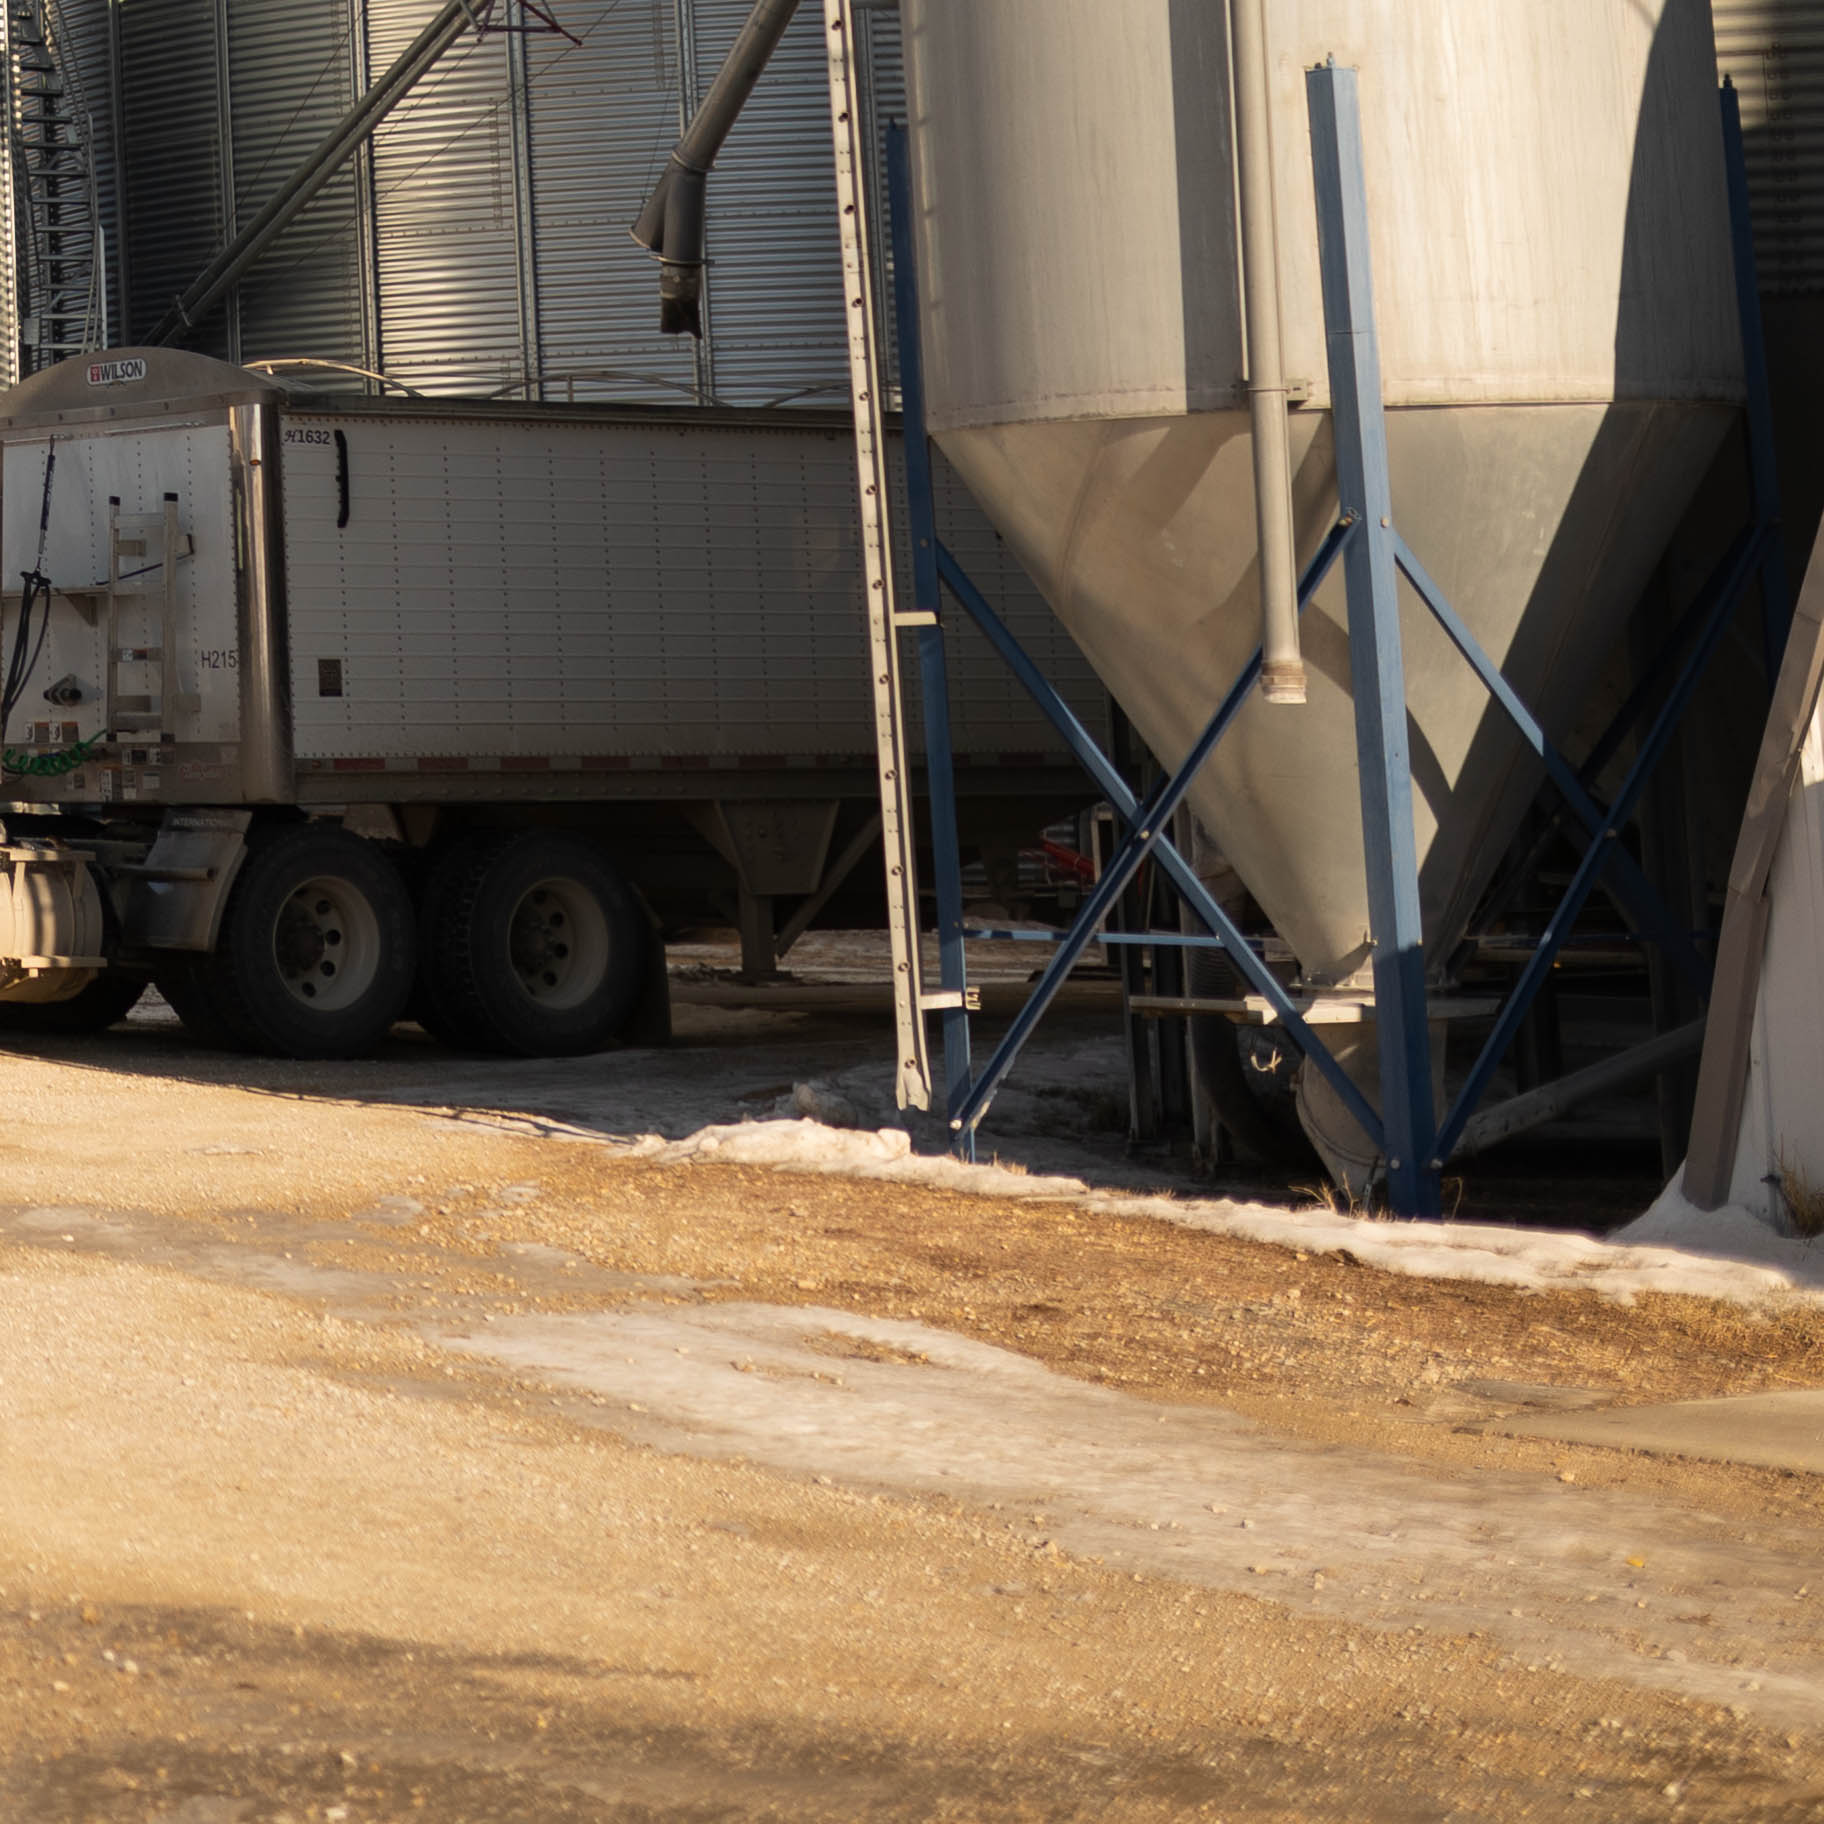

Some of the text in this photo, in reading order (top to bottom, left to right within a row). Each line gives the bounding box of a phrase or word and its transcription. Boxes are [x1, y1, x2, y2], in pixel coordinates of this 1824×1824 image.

[100, 360, 143, 381] WILSON
[284, 430, 330, 445] H1632
[201, 650, 237, 669] H215
